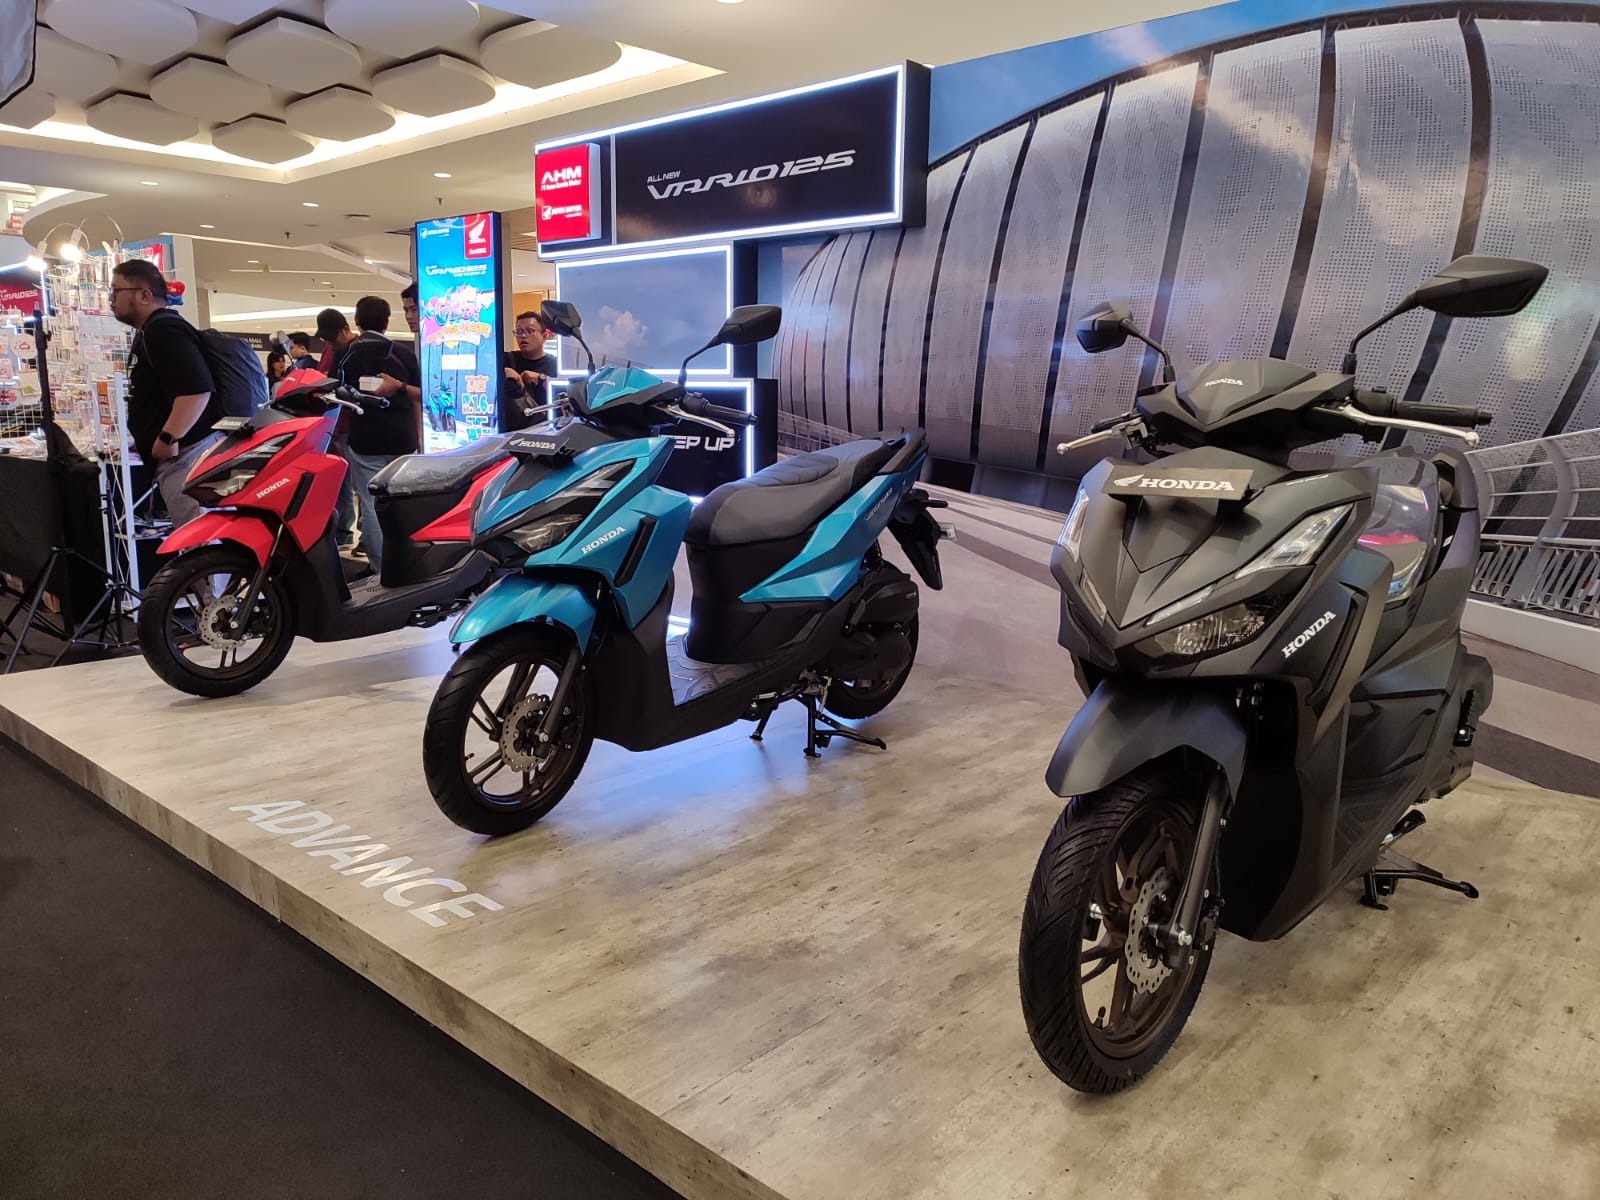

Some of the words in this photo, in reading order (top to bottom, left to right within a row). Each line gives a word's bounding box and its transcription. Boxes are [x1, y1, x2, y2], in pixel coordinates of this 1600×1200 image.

[541, 165, 582, 185] AHM
[647, 173, 662, 184] ALL
[662, 170, 681, 181] NEW
[648, 149, 856, 200] VARIO125
[1204, 378, 1244, 387] HONDA
[518, 440, 556, 450] HONDA
[658, 434, 701, 450] EP
[704, 436, 735, 451] UP
[256, 477, 290, 499] HONDA
[1138, 478, 1235, 491] HONDA
[581, 526, 627, 555] HONDA
[1281, 610, 1337, 659] HONDA
[229, 800, 505, 928] ADVANCE
